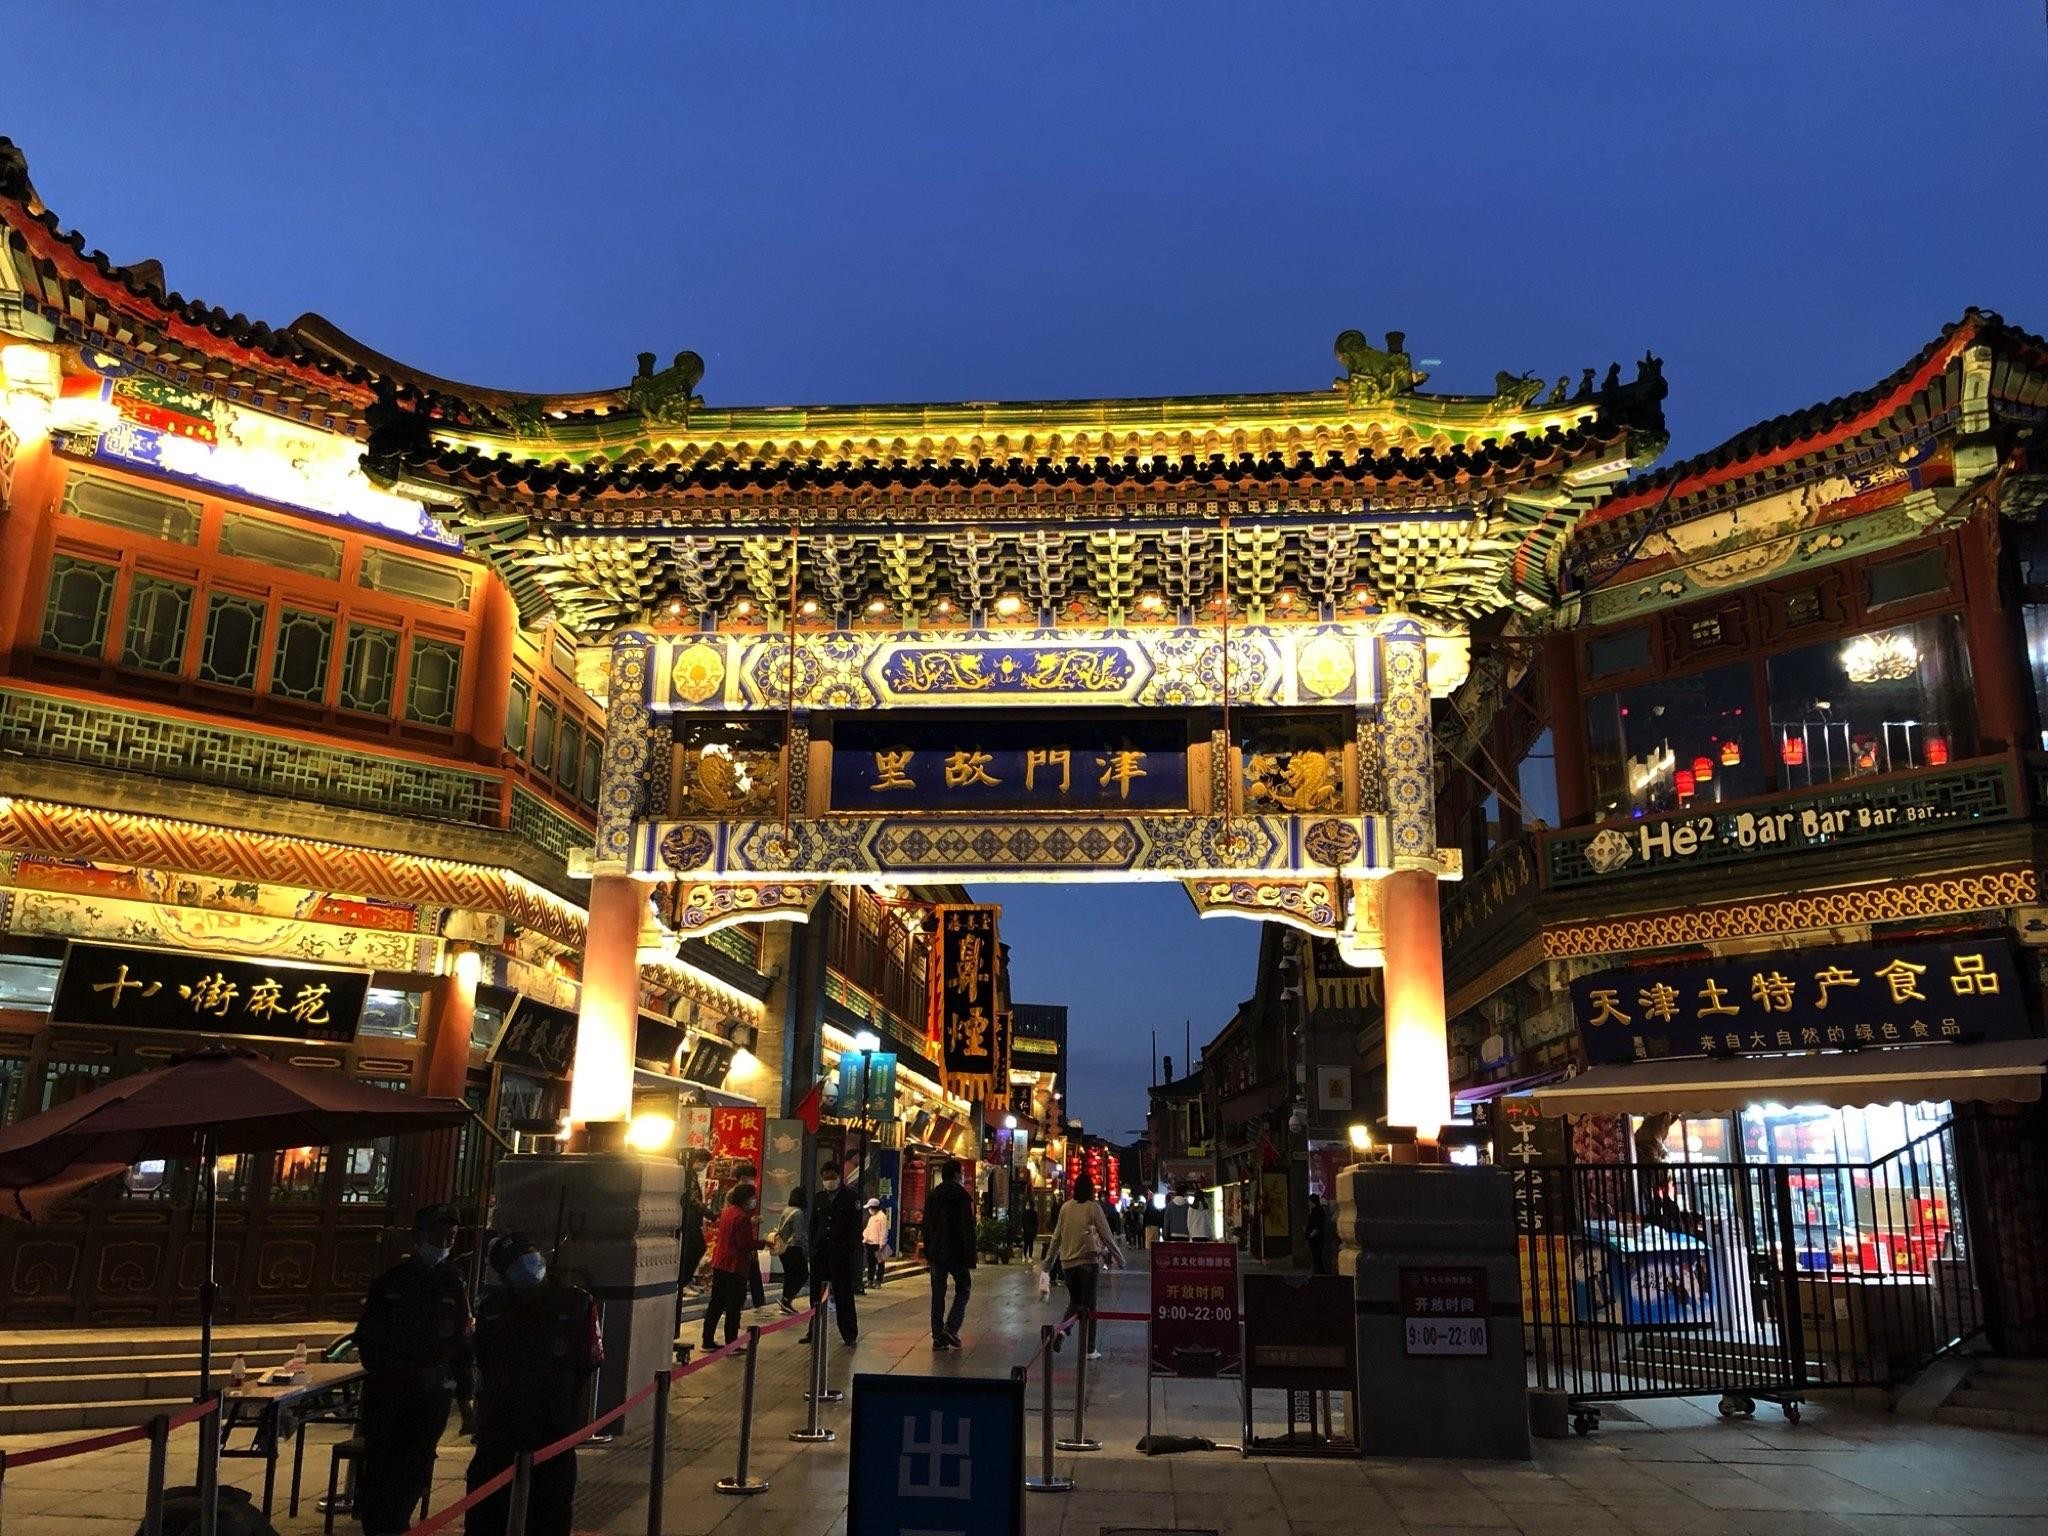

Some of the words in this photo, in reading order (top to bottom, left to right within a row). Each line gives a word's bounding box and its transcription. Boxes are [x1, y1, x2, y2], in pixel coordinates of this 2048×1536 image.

[1736, 811, 1794, 847] Bar
[1801, 808, 1851, 837] Bar
[1857, 806, 1896, 828] Bar
[93, 965, 332, 1024] 十八街麻花
[1589, 953, 2000, 1027] 天津土特产食品
[1701, 1017, 1962, 1050] 来自大自然的绿色食品
[1166, 1284, 1225, 1300] 开放时间
[1415, 1296, 1474, 1312] 开放时间
[1158, 1305, 1232, 1321] 9:00~22:00
[898, 1411, 972, 1536] 出
